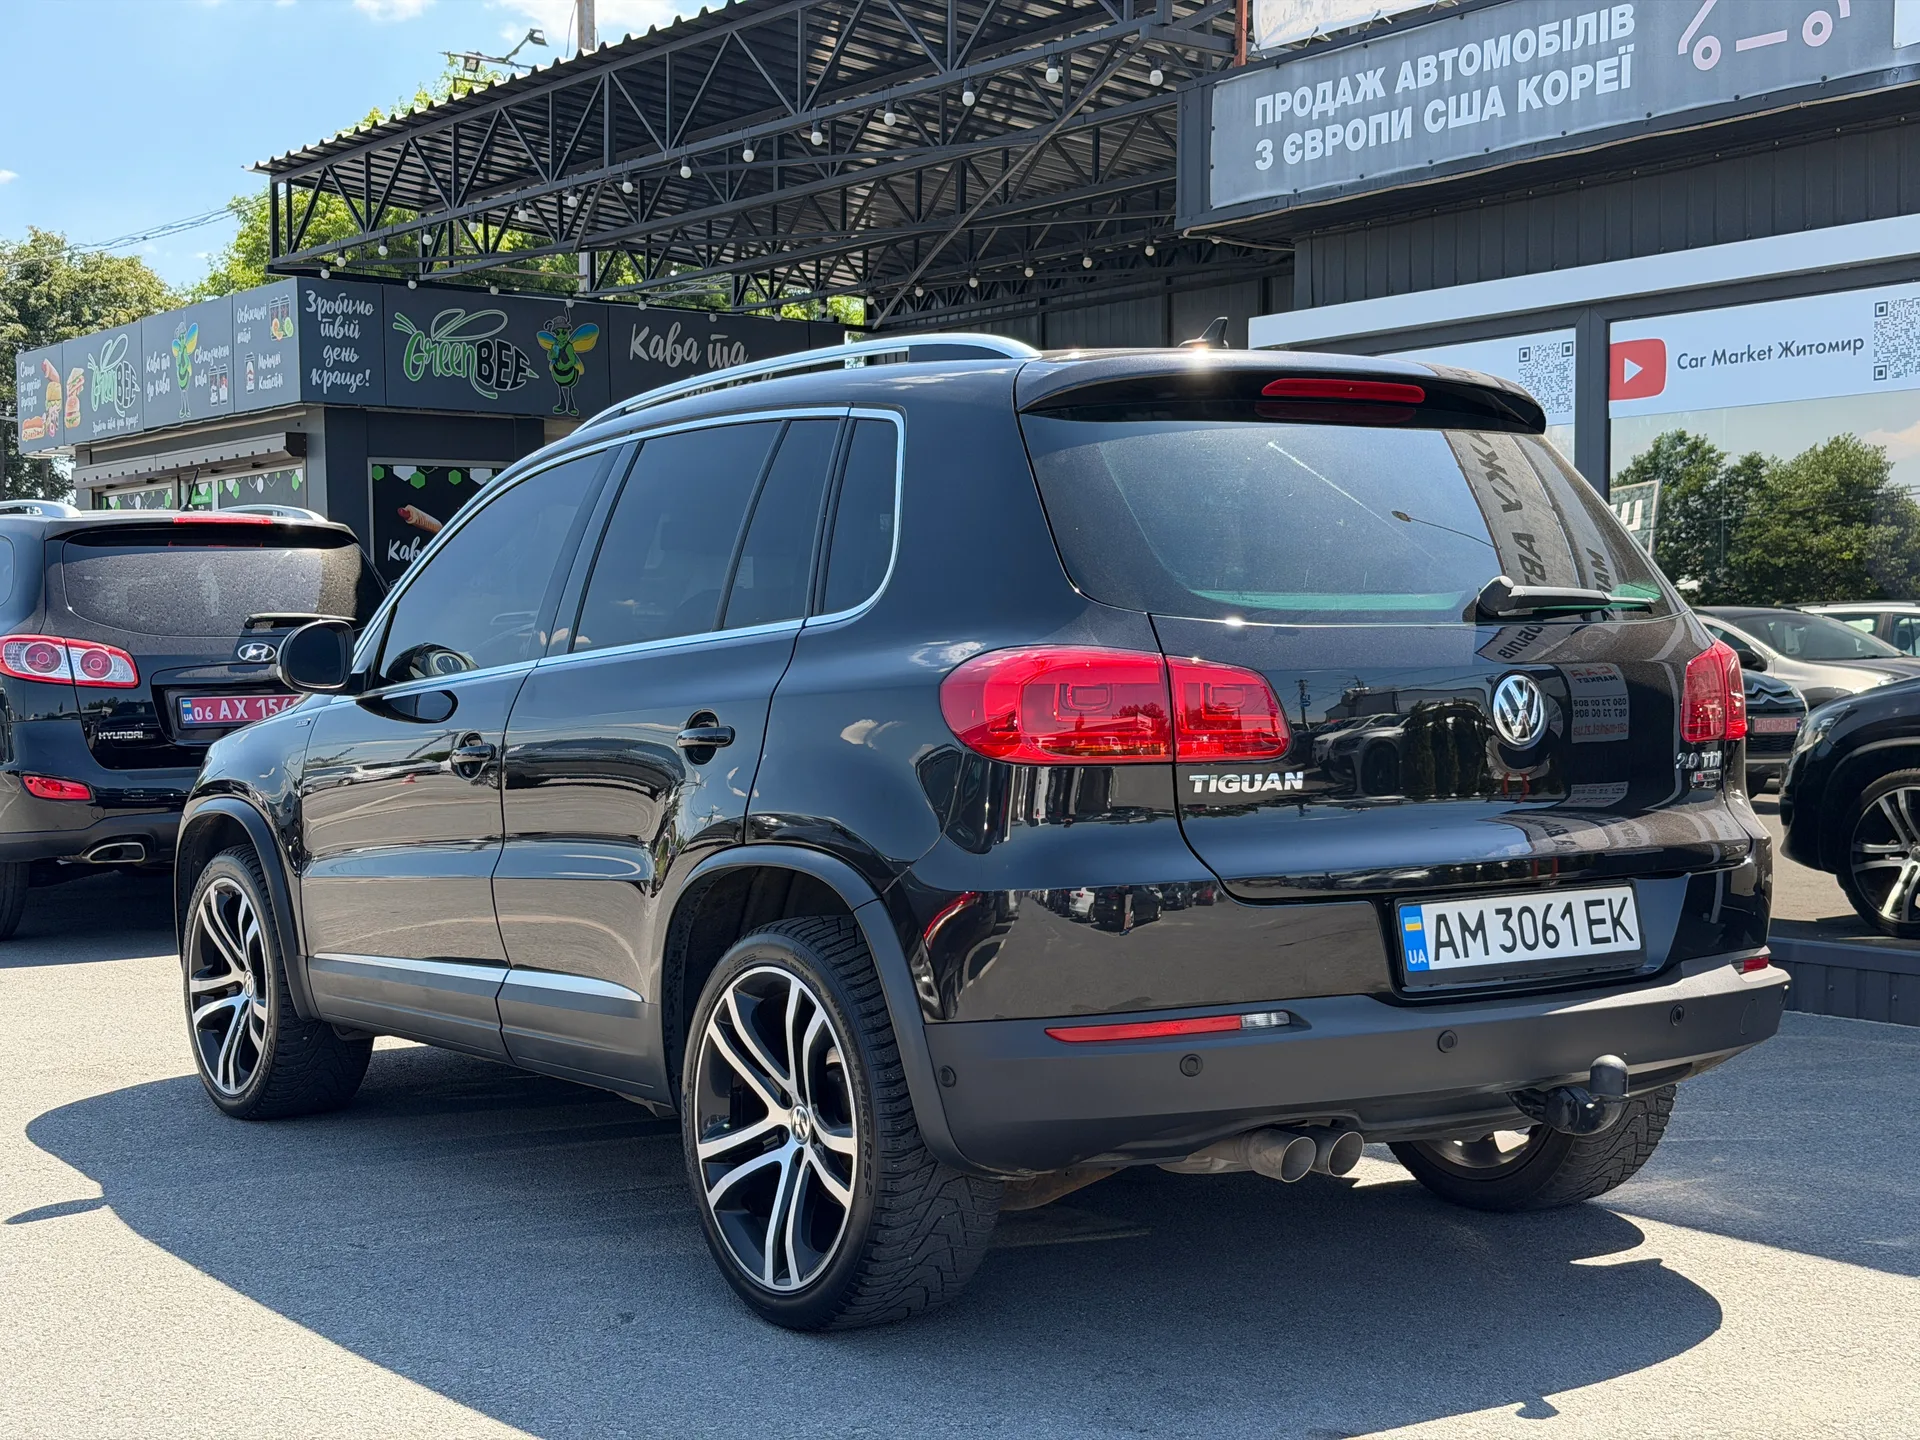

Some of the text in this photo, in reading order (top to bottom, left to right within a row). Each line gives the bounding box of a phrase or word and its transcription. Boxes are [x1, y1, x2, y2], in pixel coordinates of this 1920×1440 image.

[1255, 3, 1636, 127] ПРОДАЖ АВТОМОБІЛІВ
[1254, 43, 1635, 171] З ЄВРОПИ США КОРЕЇ
[305, 290, 374, 321] Зробимо
[320, 315, 361, 340] твій
[323, 344, 360, 368] день
[629, 321, 749, 369] Кава та
[1677, 337, 1865, 370] Car Market Житомир
[310, 367, 371, 395] краще!
[387, 536, 427, 563] Кав
[183, 713, 194, 721] UA
[193, 697, 299, 721] 06 AX 156
[98, 730, 144, 740] HYUNDAI
[1701, 750, 1722, 768] TDI
[1188, 771, 1304, 794] TIGUAN
[1433, 896, 1635, 962] AM 3061 EK
[1408, 950, 1428, 965] UA
